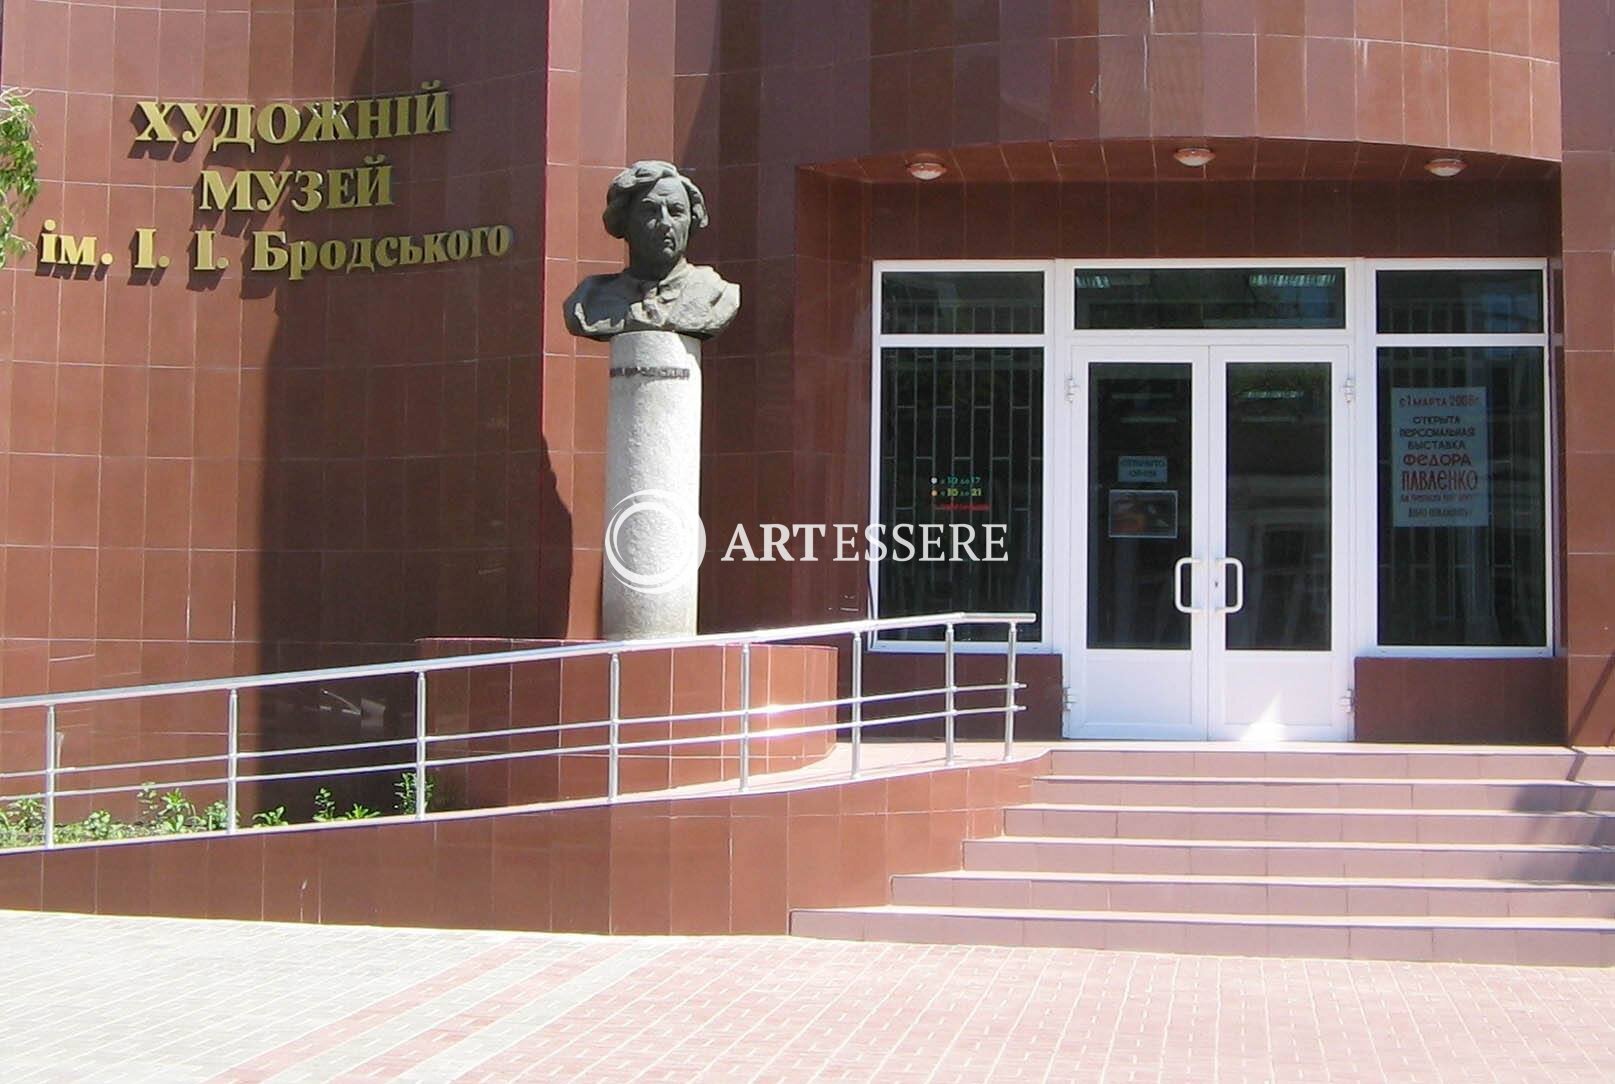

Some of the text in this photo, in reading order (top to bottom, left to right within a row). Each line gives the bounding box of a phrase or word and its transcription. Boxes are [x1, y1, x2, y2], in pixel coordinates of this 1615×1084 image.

[135, 80, 452, 153] ХУДОЖНІЙ
[199, 154, 394, 212] МУЗЕЙ
[40, 219, 114, 266] ім.
[251, 224, 513, 281] Бродського
[1403, 453, 1472, 466] ФЕДОРА
[947, 488, 959, 497] 10
[971, 488, 982, 497] 21
[1402, 470, 1478, 491] ПАВЛЕНКО
